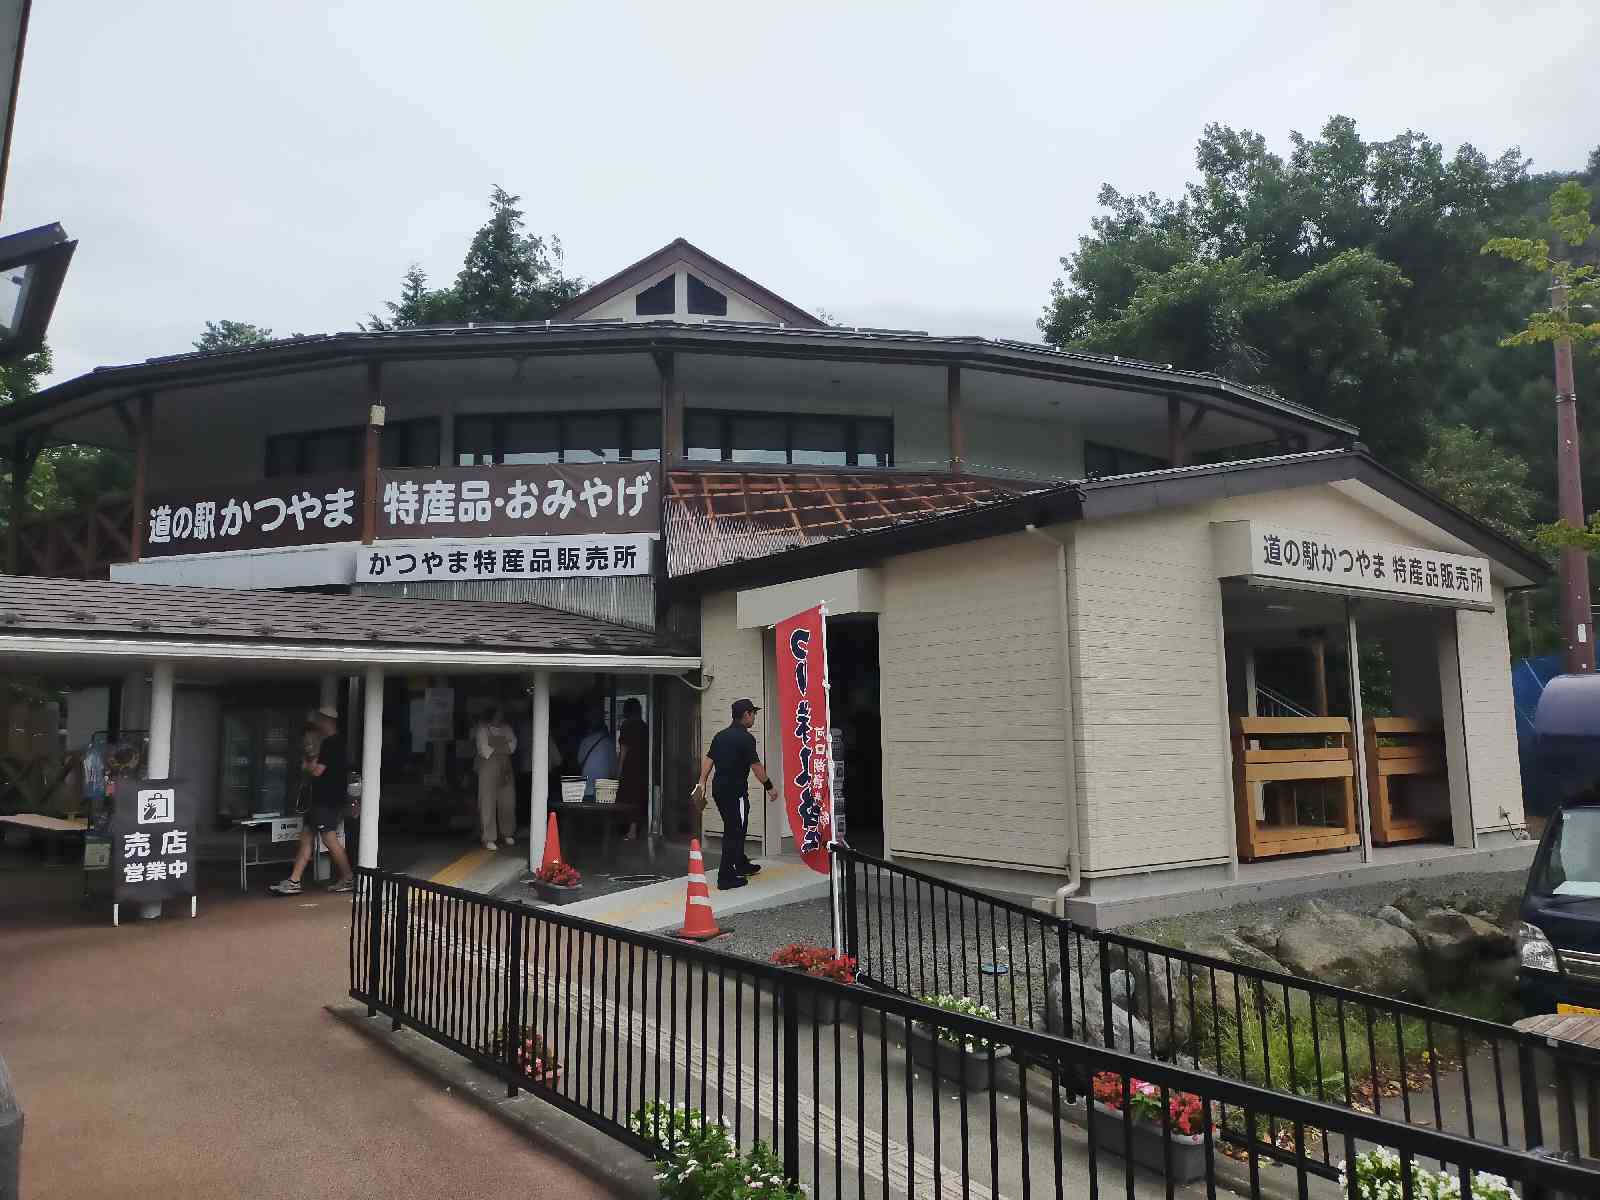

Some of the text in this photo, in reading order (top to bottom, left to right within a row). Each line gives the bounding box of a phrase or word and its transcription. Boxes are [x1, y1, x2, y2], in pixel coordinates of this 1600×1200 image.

[149, 487, 356, 544] 道の駅かつやま
[383, 472, 652, 525] 特産品・おみやげ
[369, 545, 637, 576] かつやま特産品販売所
[1264, 534, 1483, 593] 道の駅かつやま 特産品販売所
[124, 829, 188, 858] 売店
[124, 860, 188, 883] 営業中
